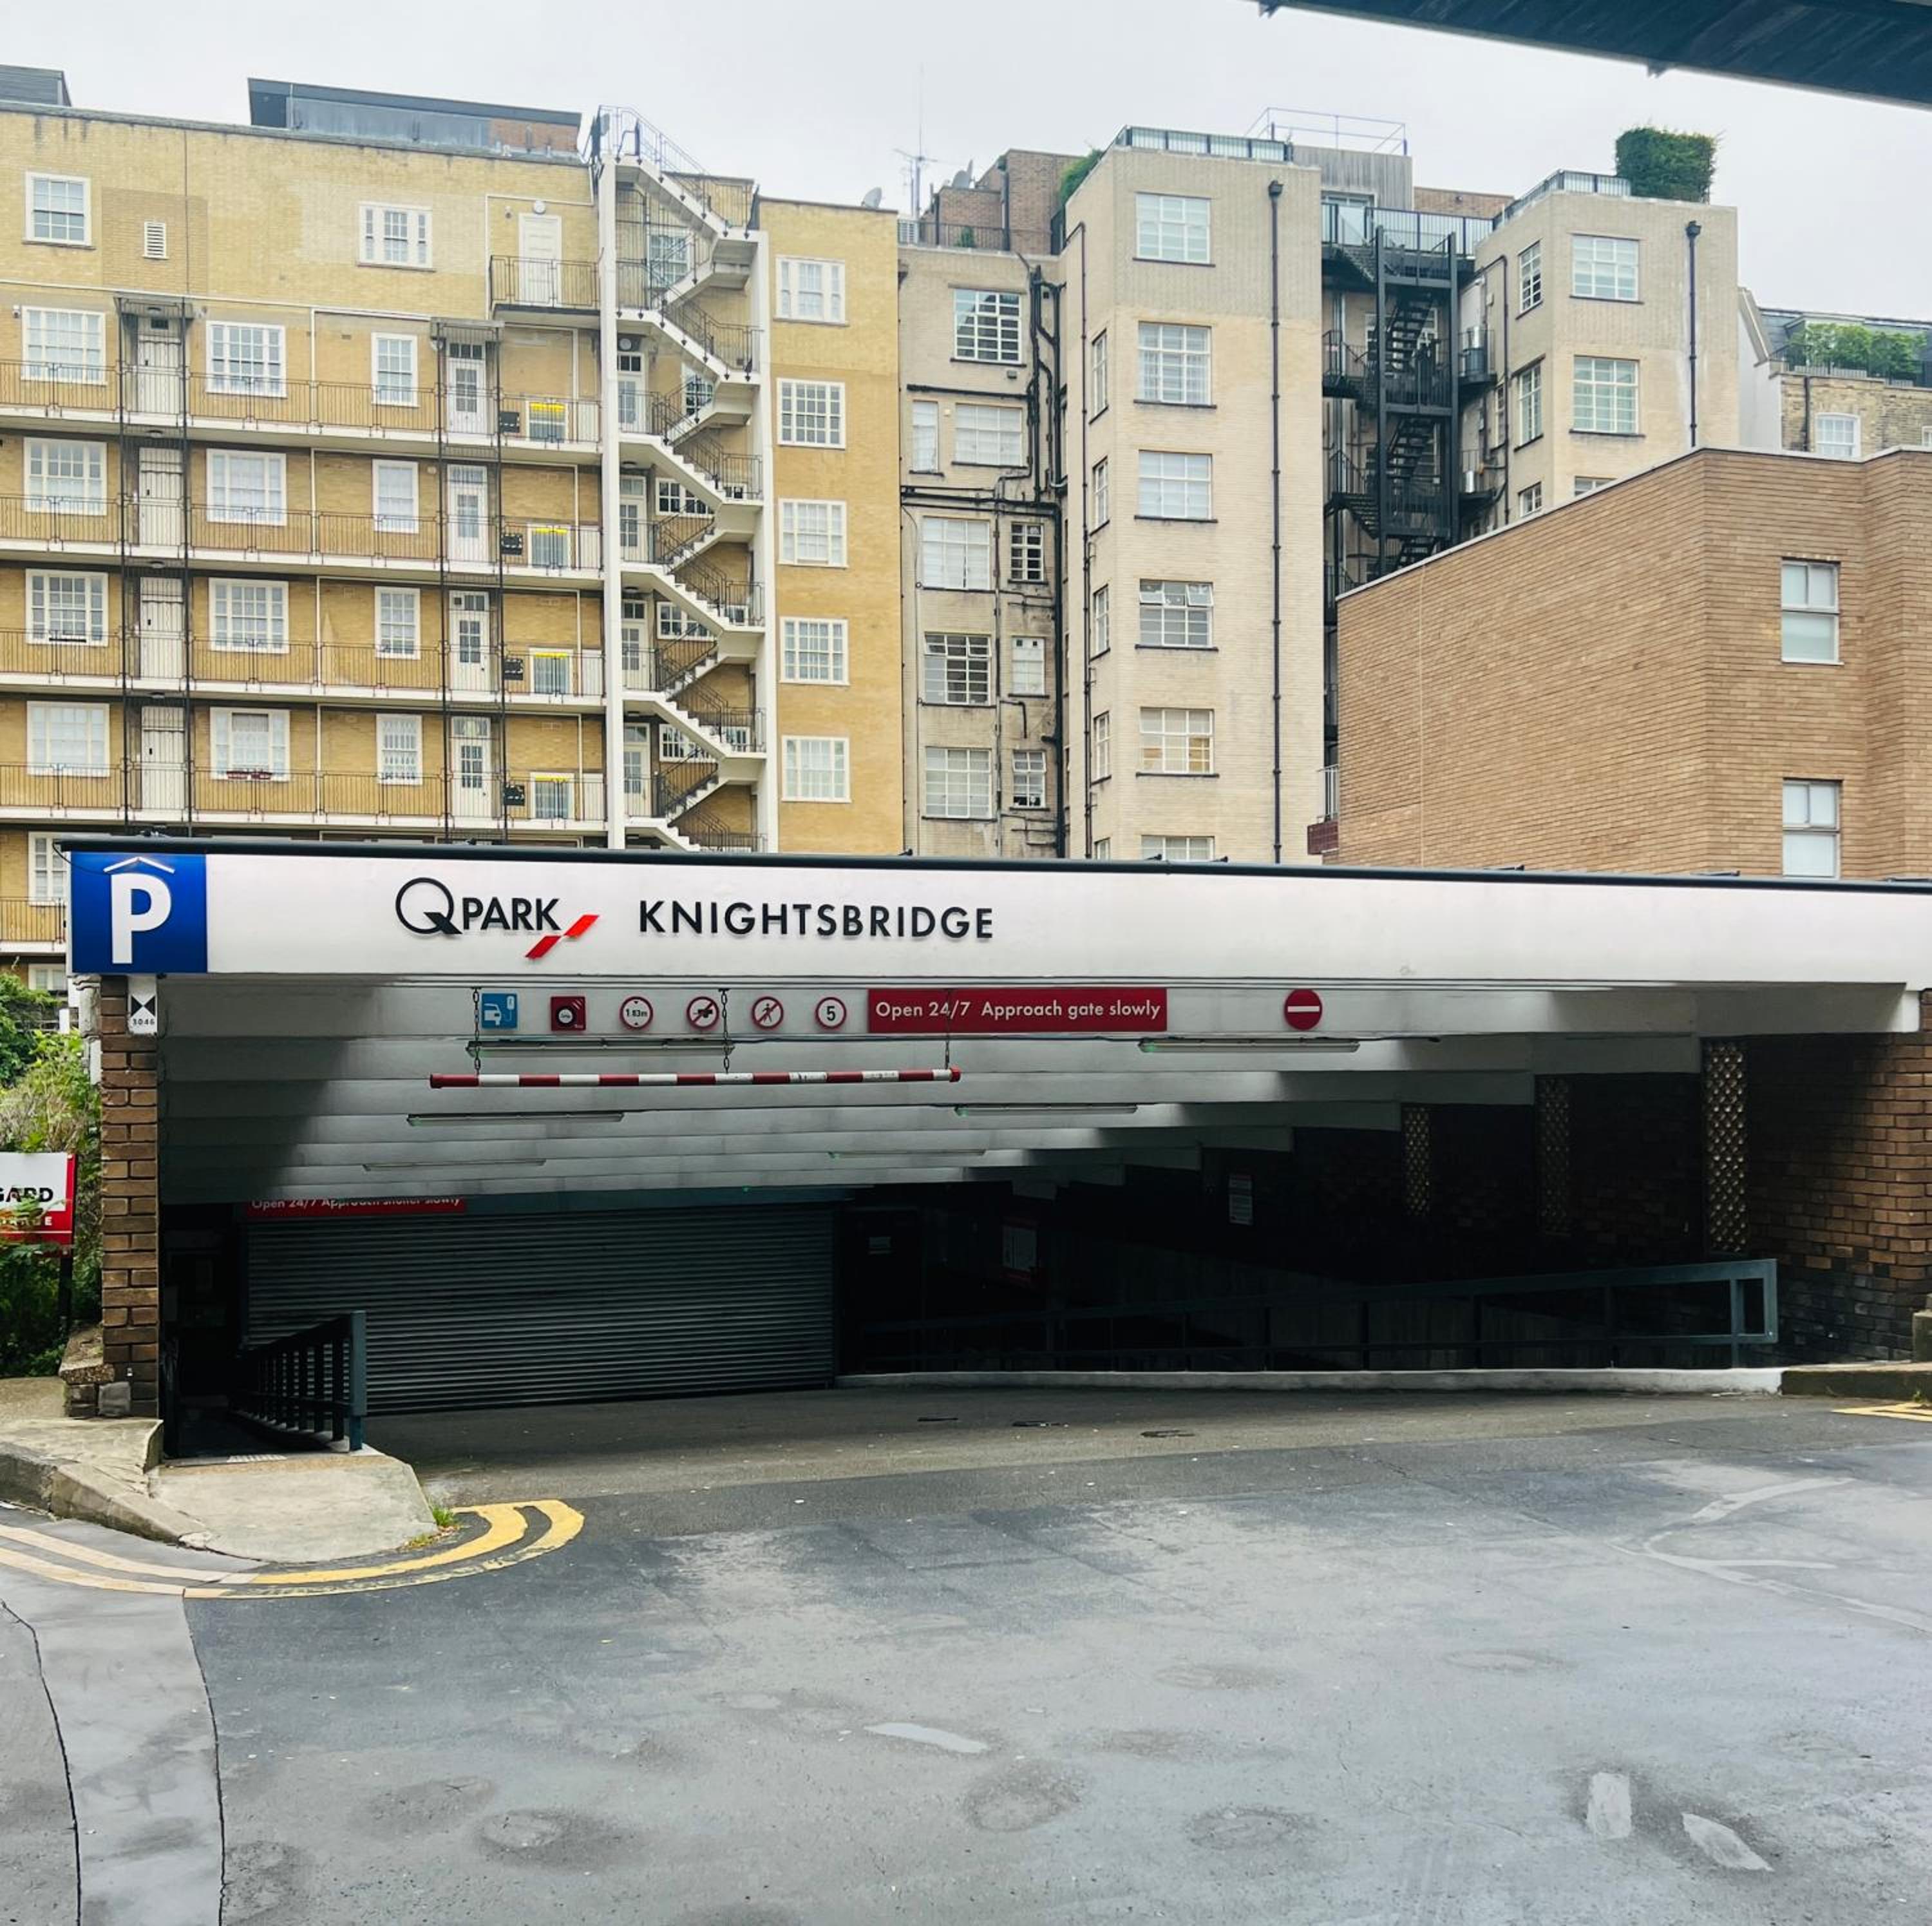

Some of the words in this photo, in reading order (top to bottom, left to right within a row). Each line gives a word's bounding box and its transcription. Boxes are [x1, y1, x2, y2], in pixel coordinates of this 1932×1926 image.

[111, 873, 171, 964] P
[639, 900, 993, 939] KNIGHTSBRIDGE
[826, 1006, 836, 1022] 5
[876, 1001, 923, 1021] Open
[929, 1000, 971, 1020] 24/7
[981, 999, 1063, 1020] Approach
[1068, 1003, 1104, 1020] gate
[1109, 999, 1160, 1019] slowly
[251, 1199, 285, 1211] Open
[289, 1198, 317, 1210] 24/7
